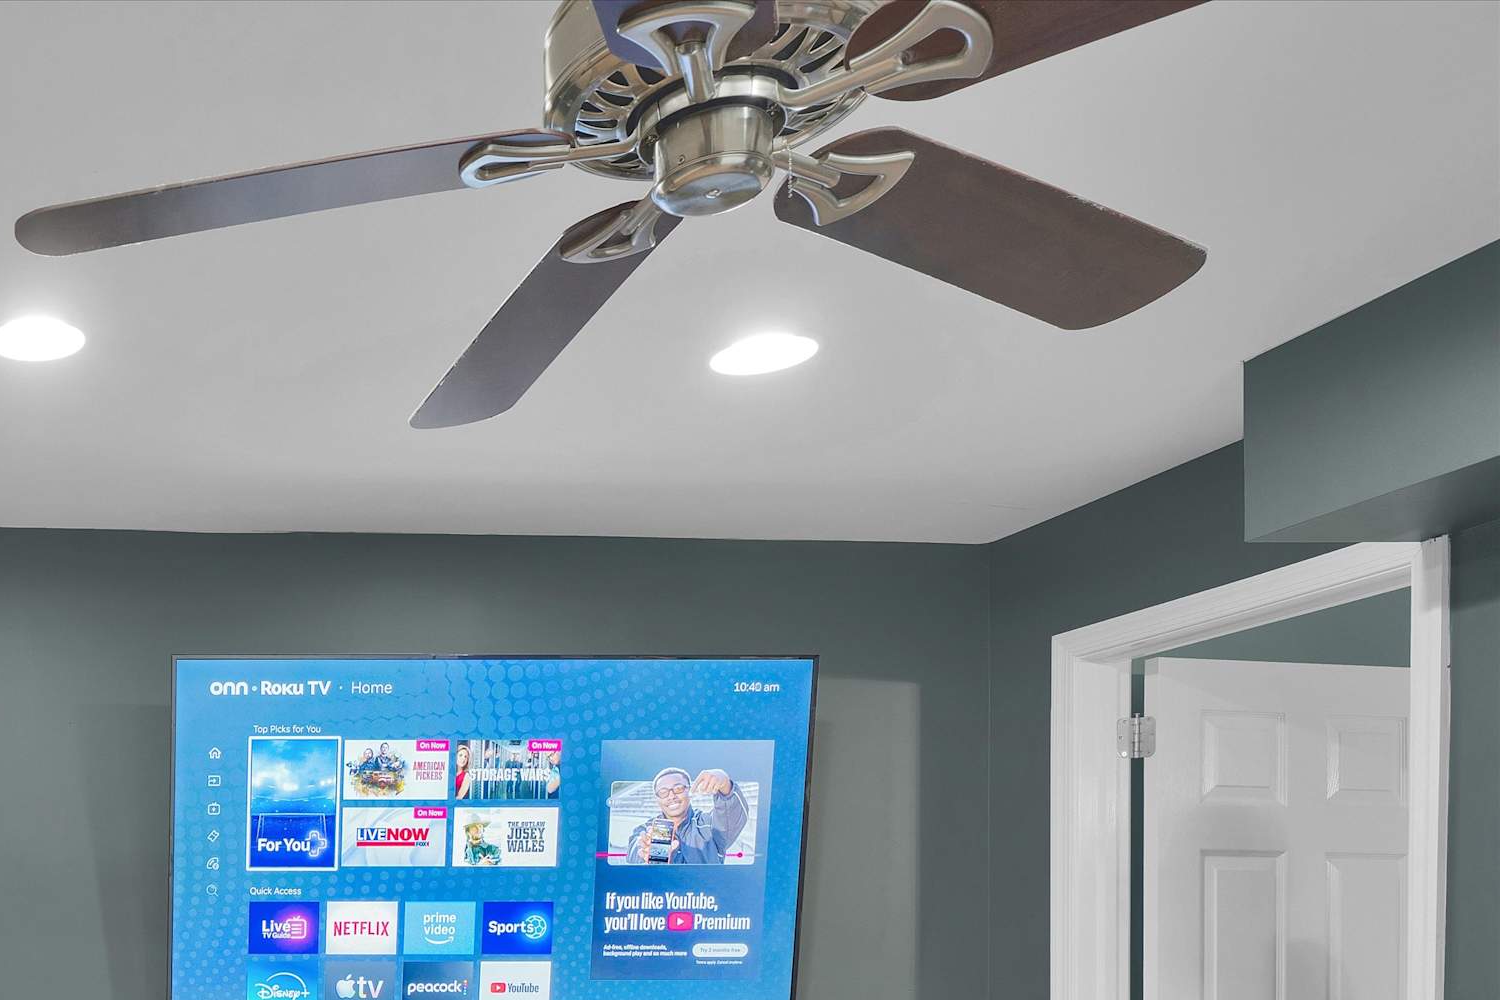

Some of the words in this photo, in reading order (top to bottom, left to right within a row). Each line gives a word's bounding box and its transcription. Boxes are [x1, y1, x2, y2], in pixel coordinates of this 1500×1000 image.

[210, 681, 248, 696] onn
[260, 680, 304, 696] Roku
[307, 680, 331, 696] TV
[351, 681, 392, 694] Home
[764, 684, 780, 692] am
[253, 725, 268, 734] Top
[270, 724, 290, 734] Picks
[292, 724, 304, 734] for
[306, 725, 321, 734] You
[413, 762, 446, 770] AMERICAN
[416, 771, 442, 780] PICKERS
[469, 768, 518, 782] STORAGE
[520, 768, 550, 782] WARS
[507, 828, 545, 840] JOSEY
[258, 838, 281, 852] For
[283, 838, 310, 852] You
[507, 840, 544, 852] WALES
[250, 887, 272, 896] Quick
[274, 887, 302, 895] Access
[606, 892, 616, 910] If
[616, 896, 639, 912] you
[642, 892, 663, 910] like
[665, 892, 718, 911] YouTube,
[424, 912, 456, 926] prime
[639, 914, 665, 930] love
[694, 914, 750, 930] Premium
[262, 920, 291, 932] Live
[334, 921, 390, 936] NETFLIX
[424, 925, 455, 935] video
[488, 920, 534, 936] Sports
[357, 976, 384, 998] tv
[407, 980, 462, 996] peacock
[508, 983, 539, 993] YouTube
